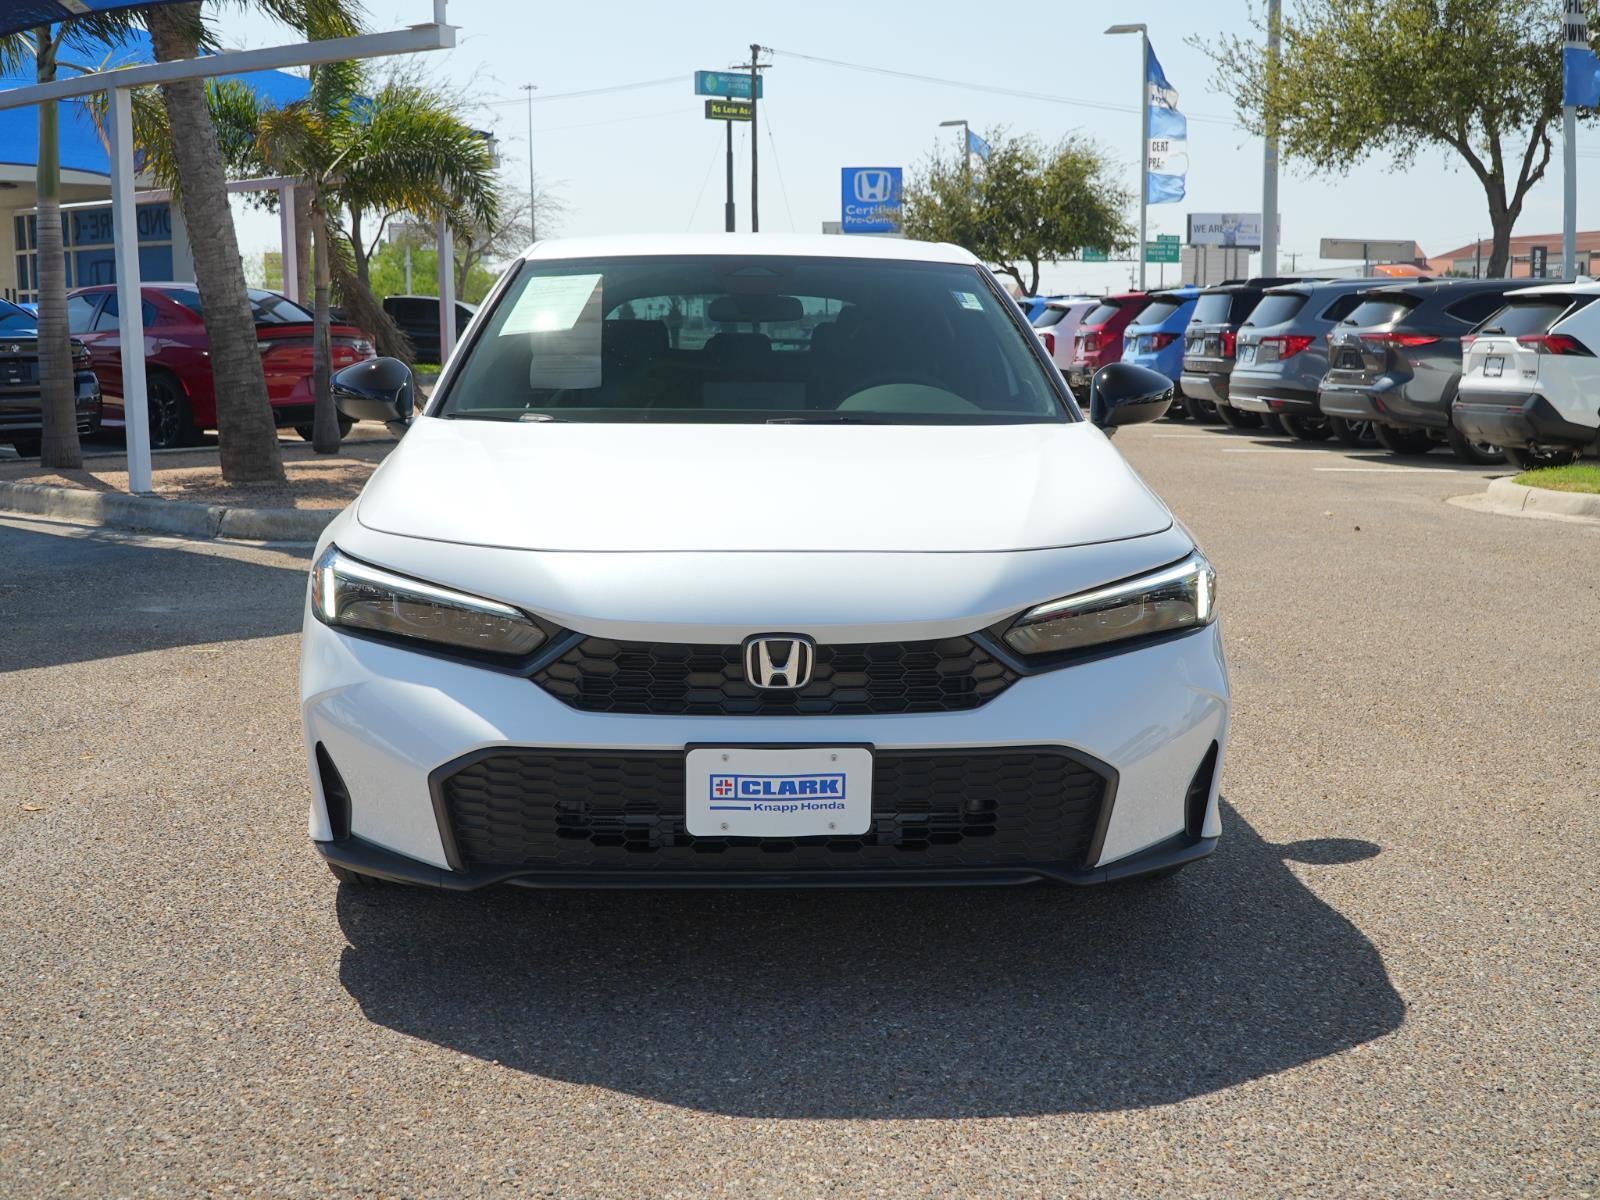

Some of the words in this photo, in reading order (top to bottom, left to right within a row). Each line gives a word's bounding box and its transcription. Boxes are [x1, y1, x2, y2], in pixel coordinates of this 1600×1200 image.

[712, 104, 721, 113] As
[1193, 223, 1207, 233] WE
[741, 779, 839, 796] CLARK
[753, 803, 798, 813] Knapp
[800, 801, 846, 811] Honda
